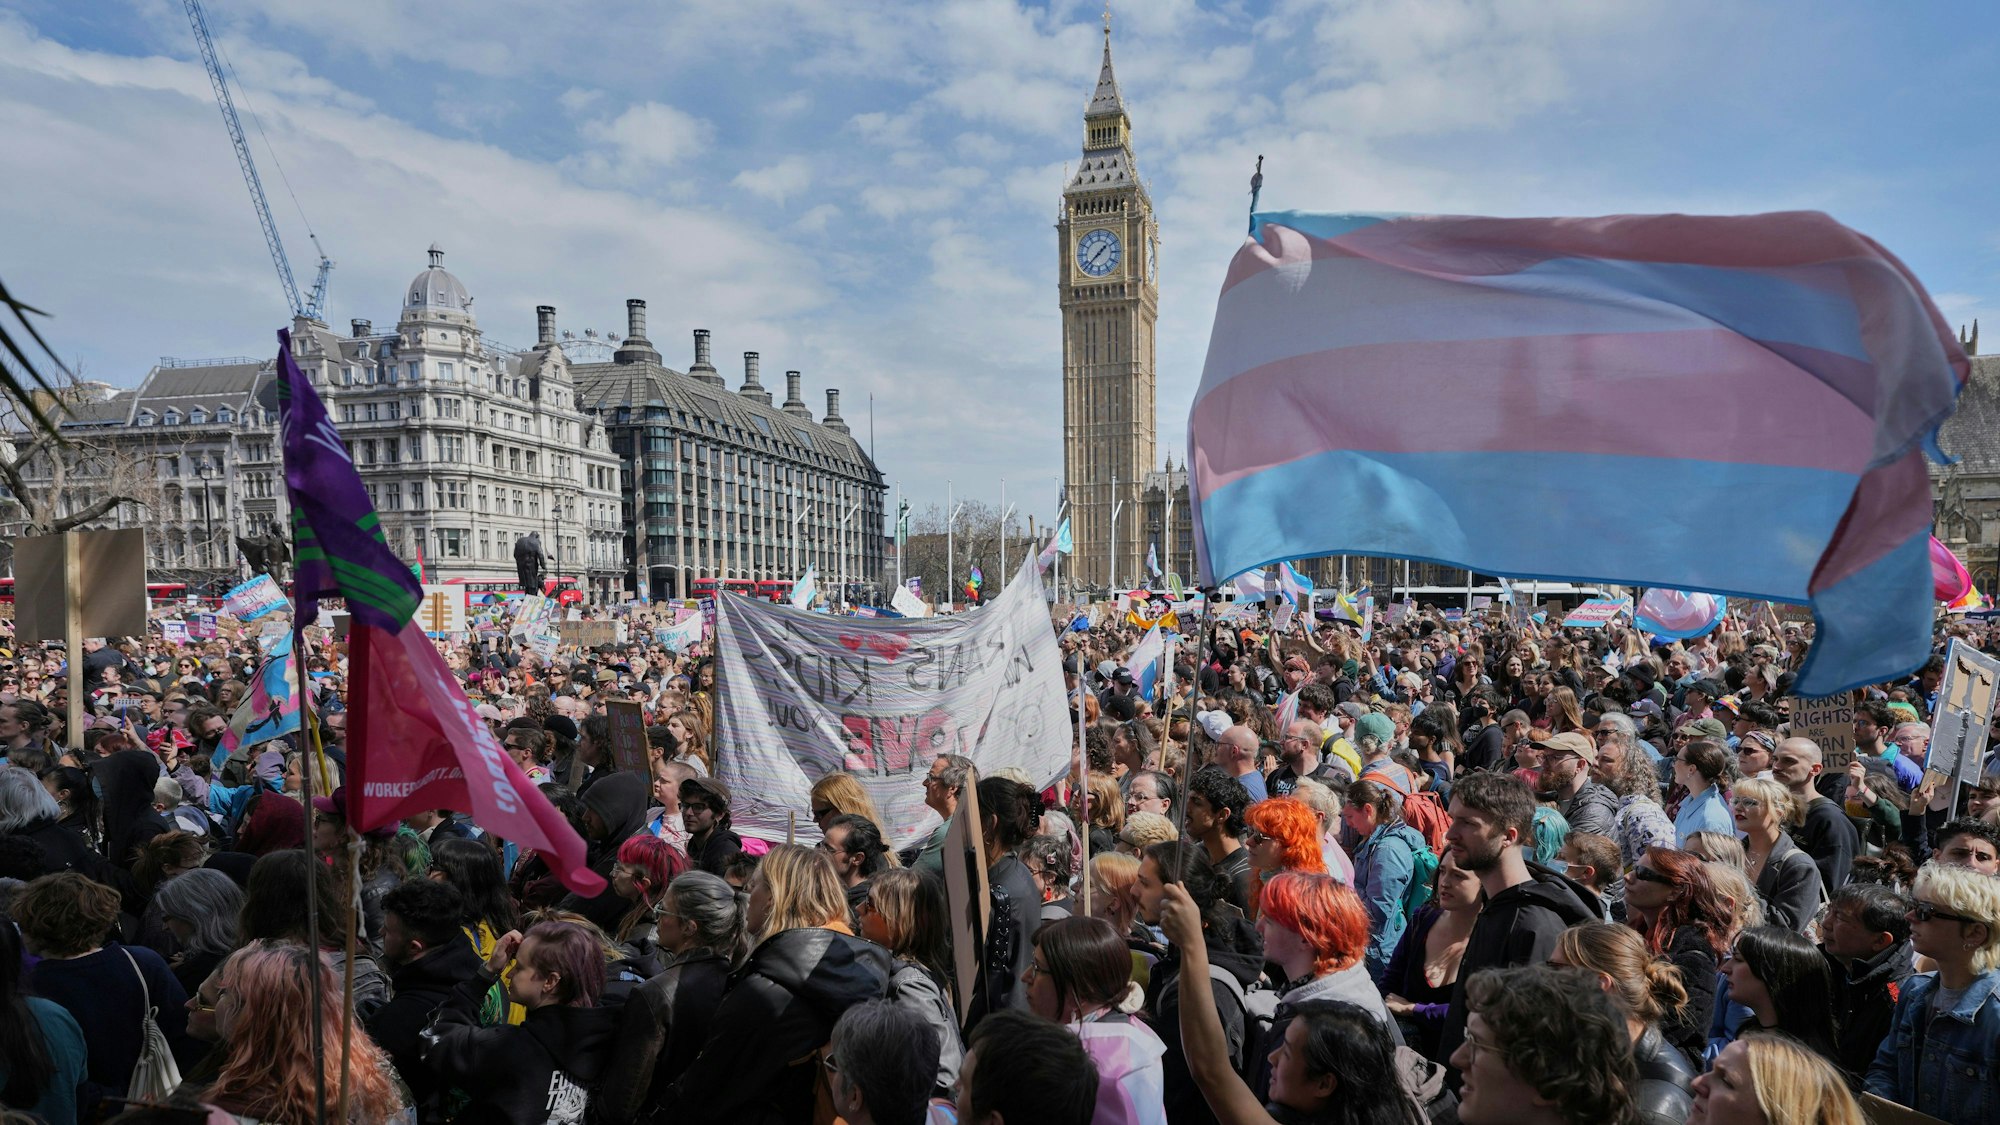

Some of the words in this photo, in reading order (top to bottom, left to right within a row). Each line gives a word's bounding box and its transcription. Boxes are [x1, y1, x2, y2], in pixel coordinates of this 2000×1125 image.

[1794, 692, 1848, 710] TRANS
[1794, 708, 1851, 729] RIGHTS
[1808, 728, 1826, 737] ARE
[1812, 735, 1846, 752] MAN
[1822, 751, 1853, 768] HTS!
